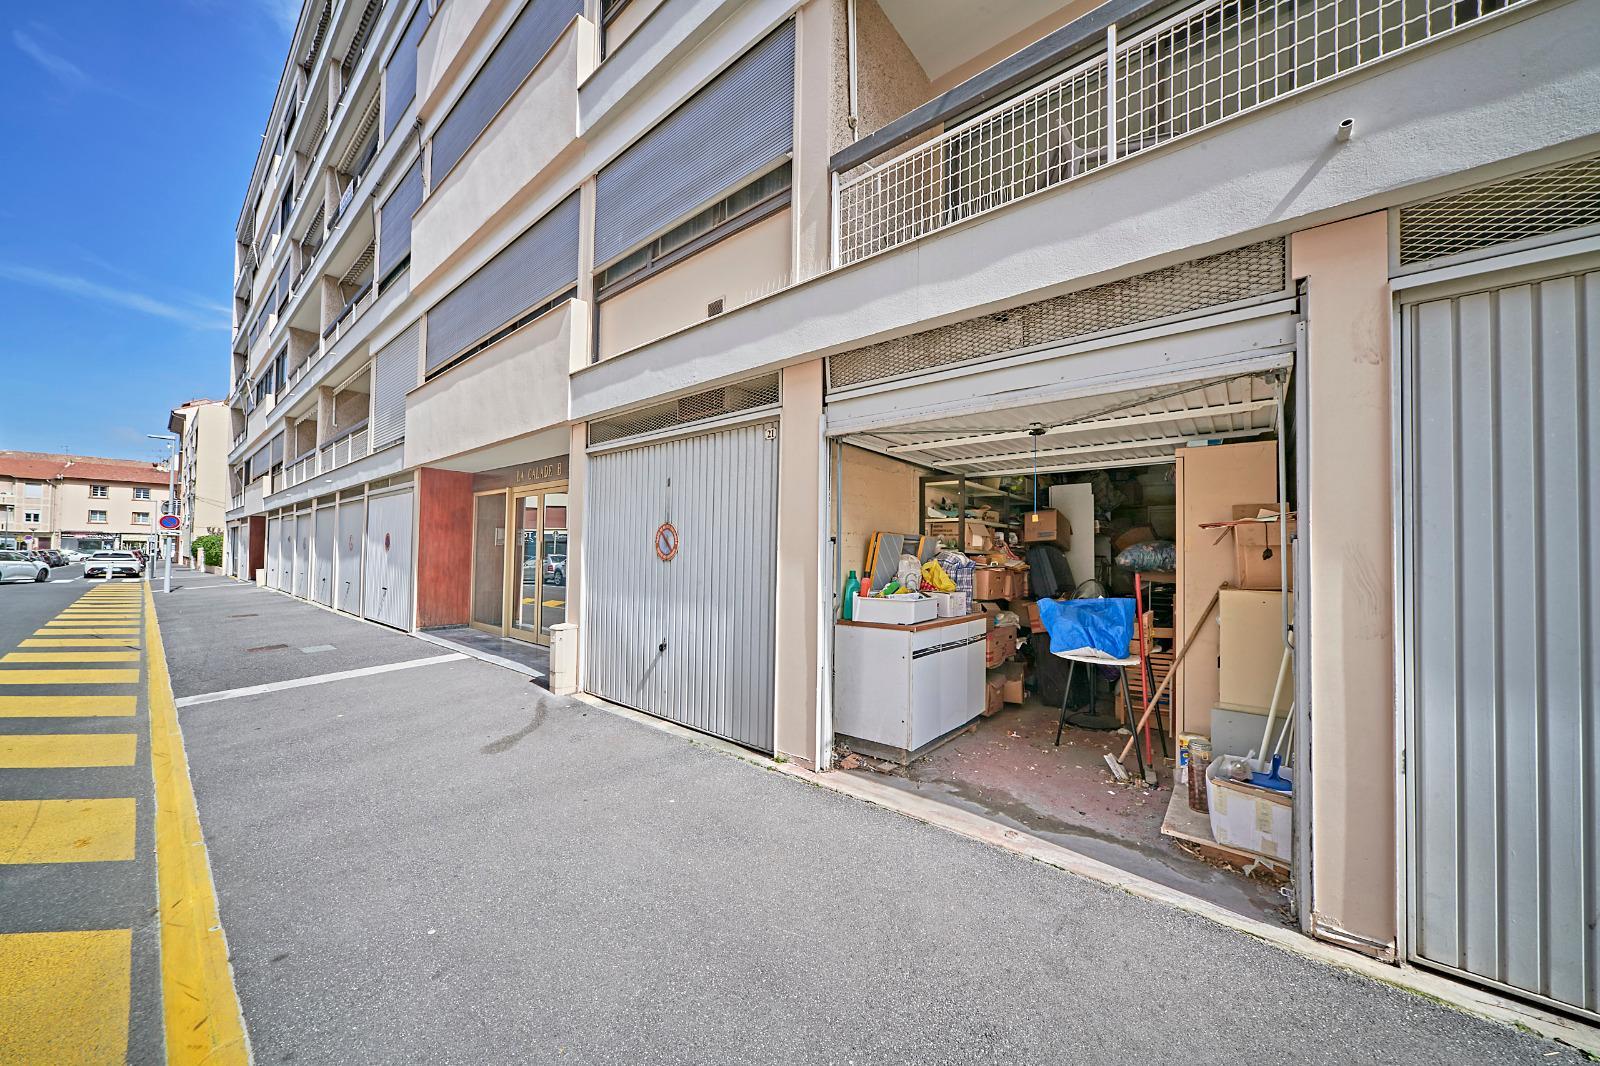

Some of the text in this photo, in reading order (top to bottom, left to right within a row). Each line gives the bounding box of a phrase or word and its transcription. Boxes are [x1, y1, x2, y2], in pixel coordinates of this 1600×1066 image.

[767, 429, 774, 438] 21
[516, 462, 562, 483] LA CALADE B
